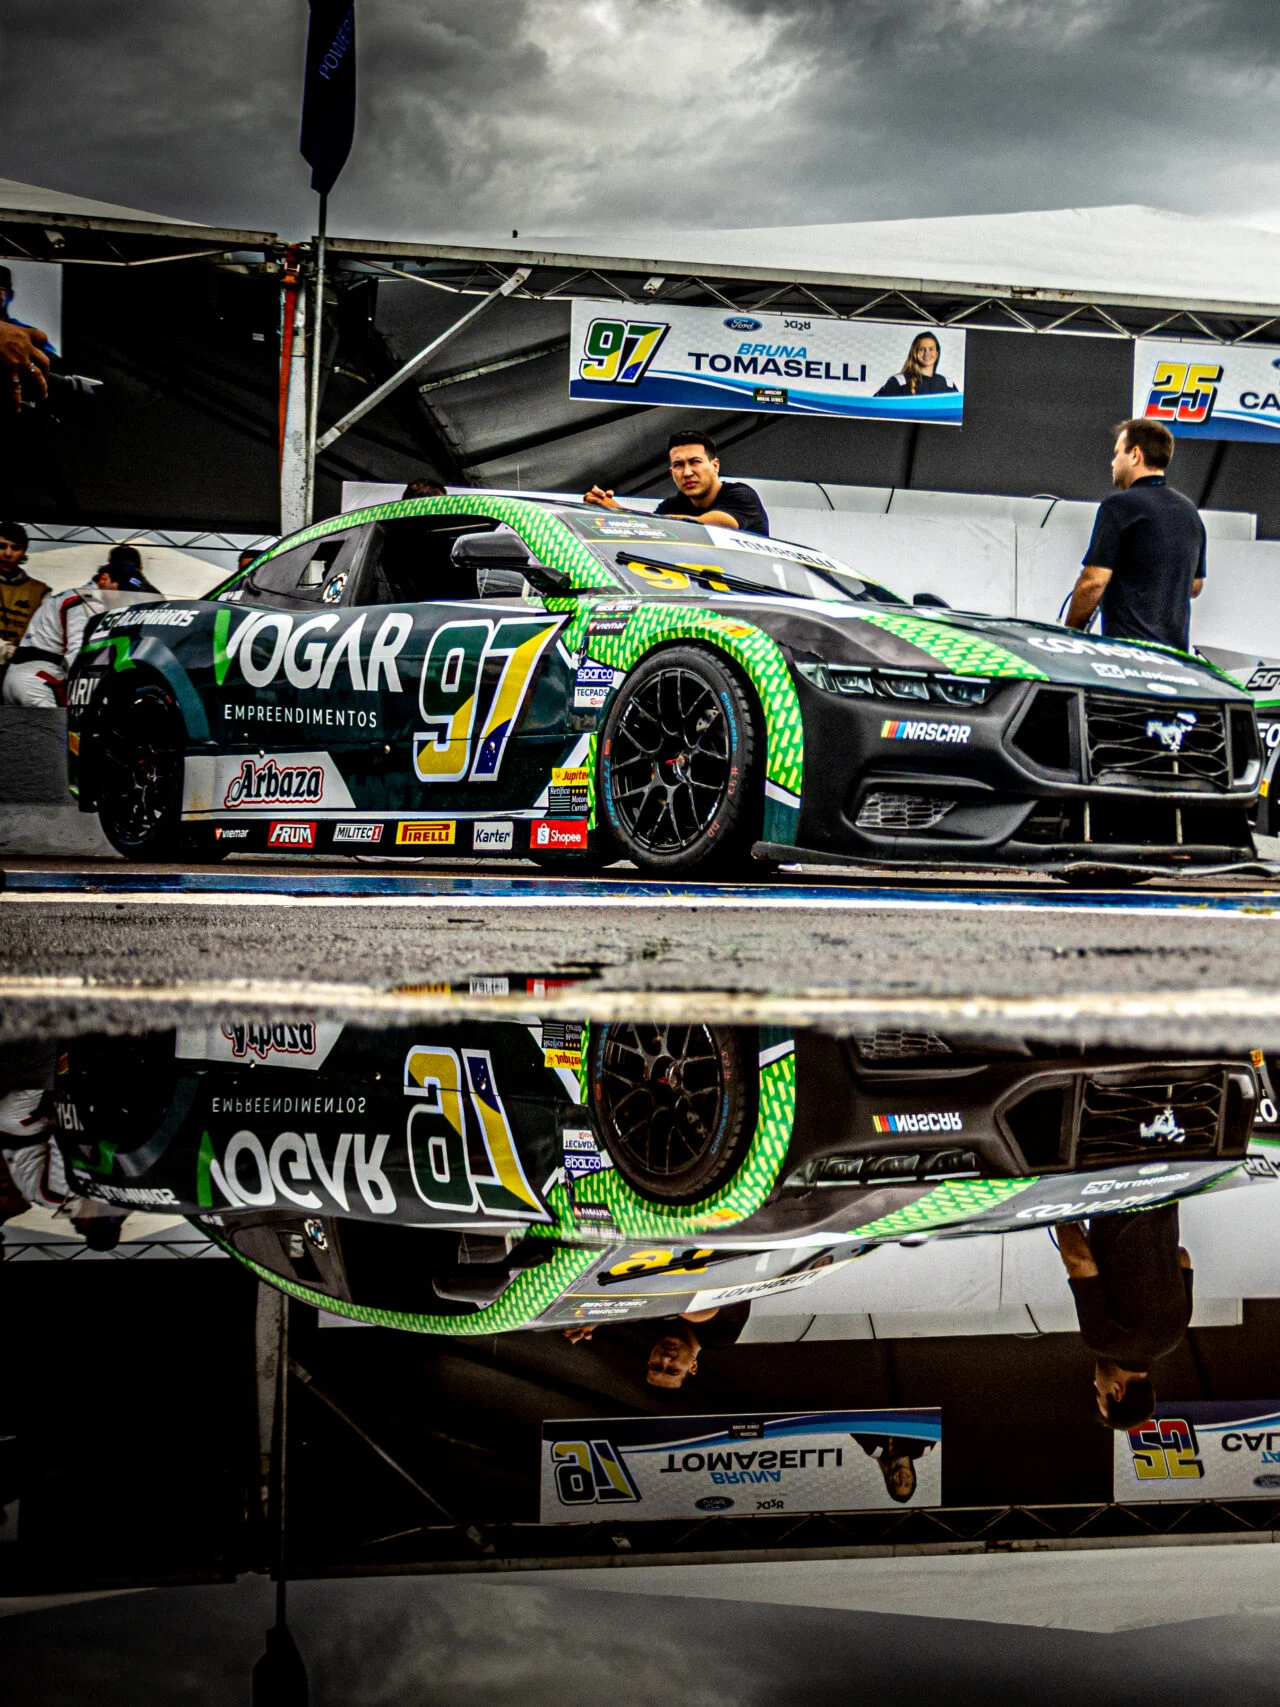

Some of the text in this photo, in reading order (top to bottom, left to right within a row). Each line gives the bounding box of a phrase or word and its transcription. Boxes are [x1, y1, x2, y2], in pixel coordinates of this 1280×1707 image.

[729, 318, 757, 331] Ford
[578, 317, 671, 386] 97
[737, 342, 808, 360] BRUNA
[687, 351, 868, 383] TOMASELLI
[1143, 360, 1224, 425] 25
[730, 537, 837, 570] TOMASELLI
[213, 609, 414, 693] VOGAR
[577, 668, 613, 682] sparco
[412, 613, 570, 783] 97
[577, 688, 609, 697] TECPADS
[224, 704, 378, 728] EMPREENDIMENTOS
[903, 721, 971, 743] NASCAR
[226, 760, 323, 807] Arbaza
[221, 826, 250, 840] viemar
[270, 824, 313, 845] FRUM
[400, 823, 450, 843] PIRELLI
[475, 828, 511, 845] Karter
[550, 829, 582, 846] Shopee
